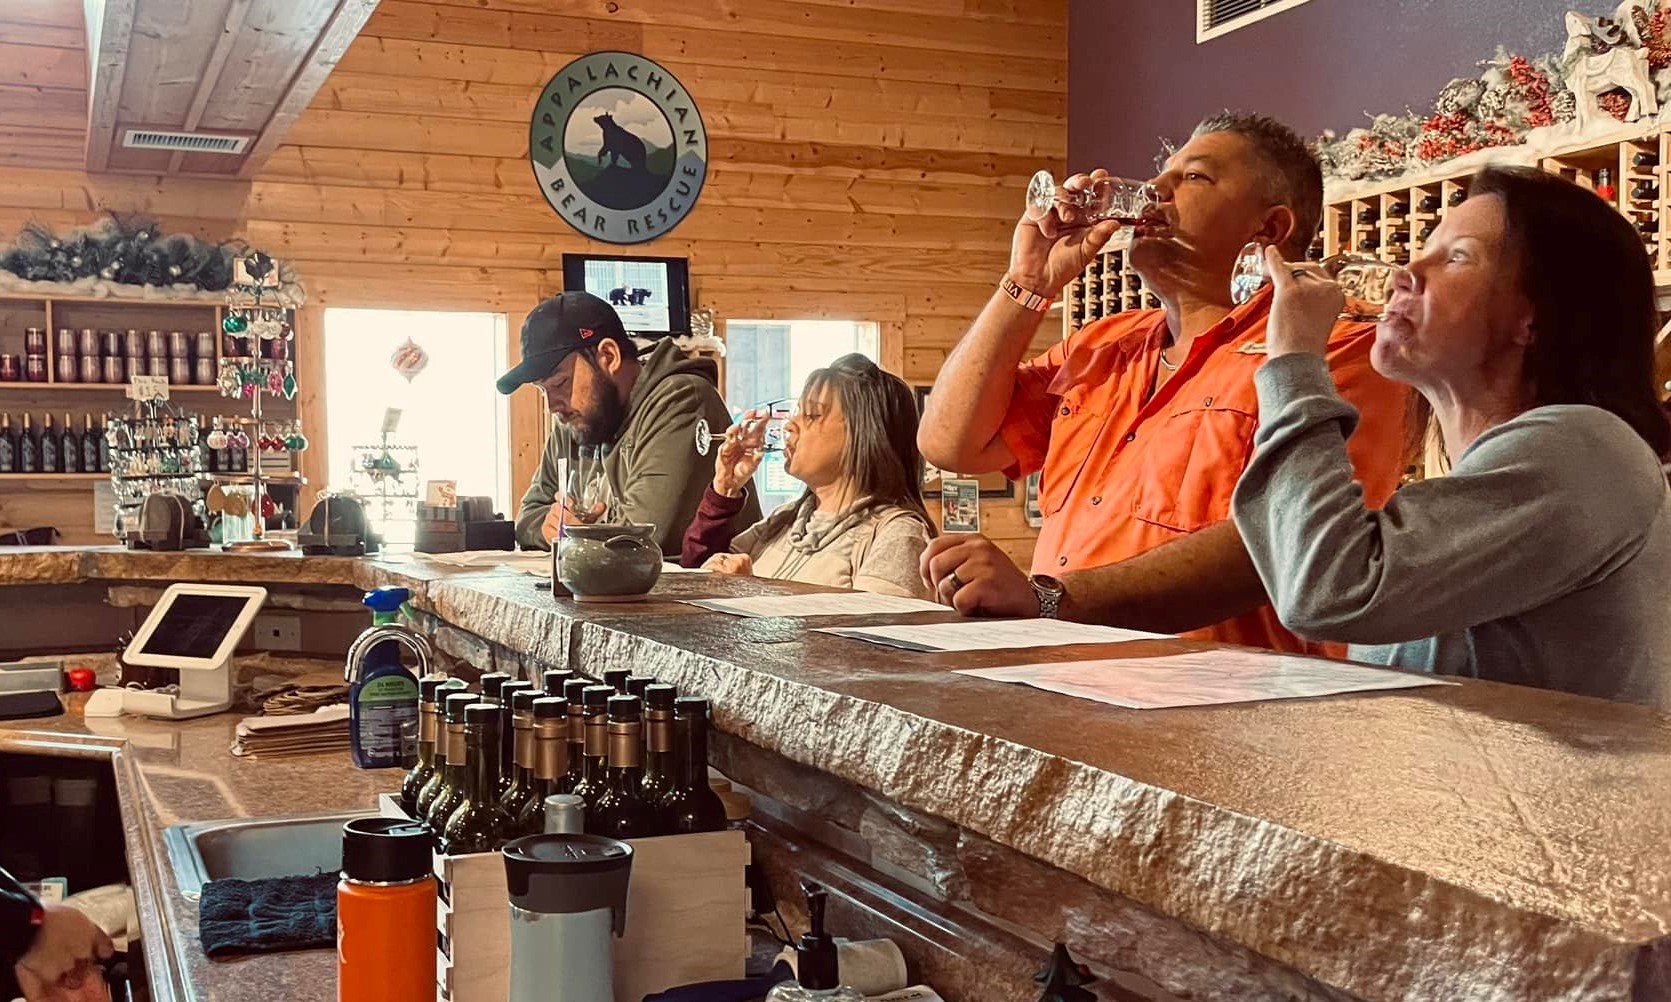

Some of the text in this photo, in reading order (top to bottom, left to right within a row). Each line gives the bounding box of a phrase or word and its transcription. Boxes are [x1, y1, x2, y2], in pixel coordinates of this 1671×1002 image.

[540, 62, 698, 152] APPALACHIAN
[551, 165, 697, 235] BEAR RESCUE
